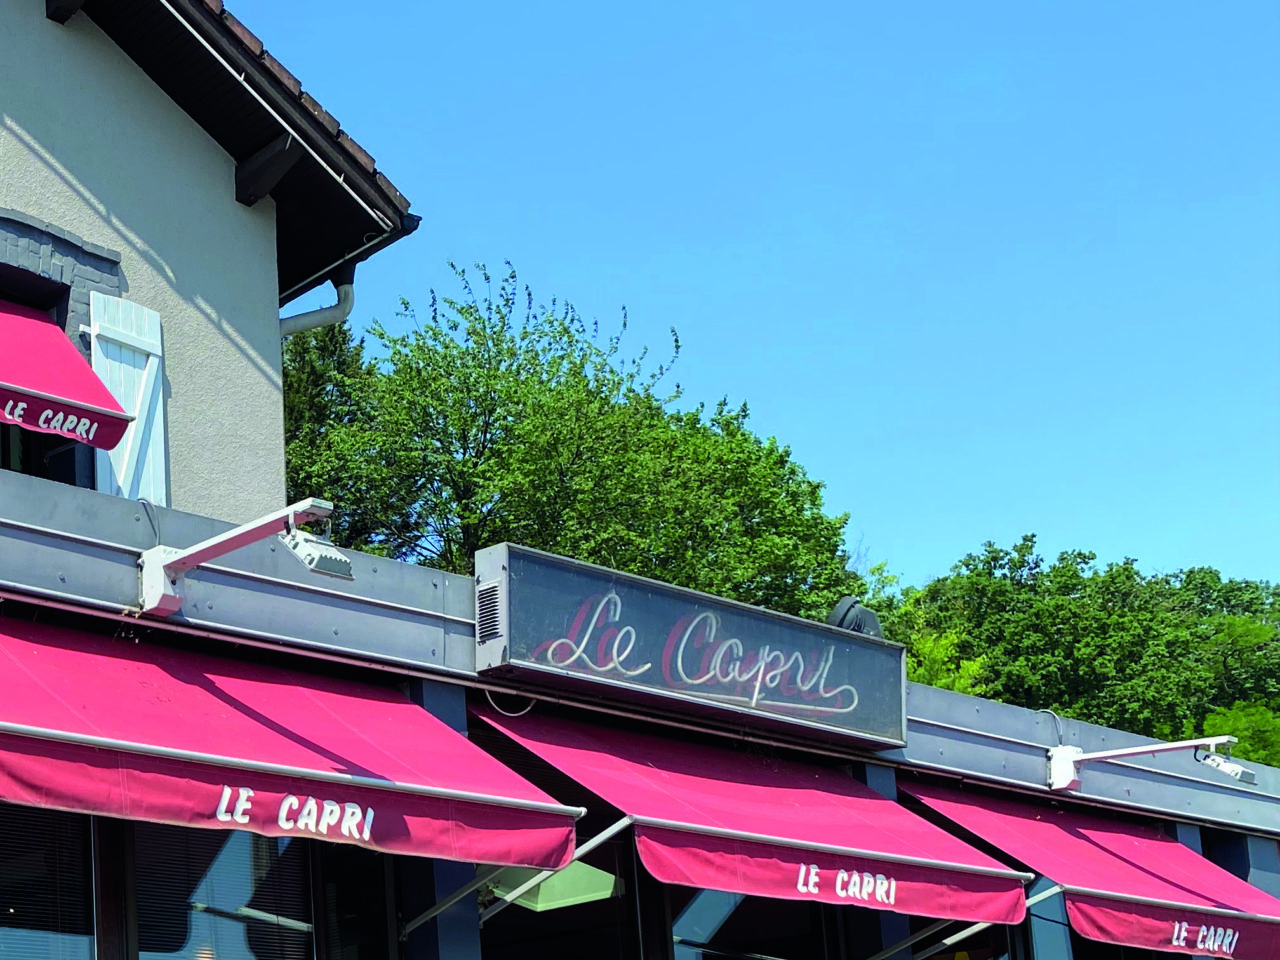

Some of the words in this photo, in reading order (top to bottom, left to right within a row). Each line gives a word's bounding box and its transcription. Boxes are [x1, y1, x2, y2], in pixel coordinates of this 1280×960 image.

[4, 399, 27, 422] LE
[38, 408, 98, 440] CAPRI
[546, 592, 651, 677] Le
[670, 611, 858, 714] Capri
[216, 784, 254, 824] LE
[277, 794, 375, 842] CAPRI
[796, 862, 820, 894] LE
[835, 868, 896, 905] CAPRI
[1172, 920, 1189, 947] LE
[1196, 924, 1239, 954] CAPRI
